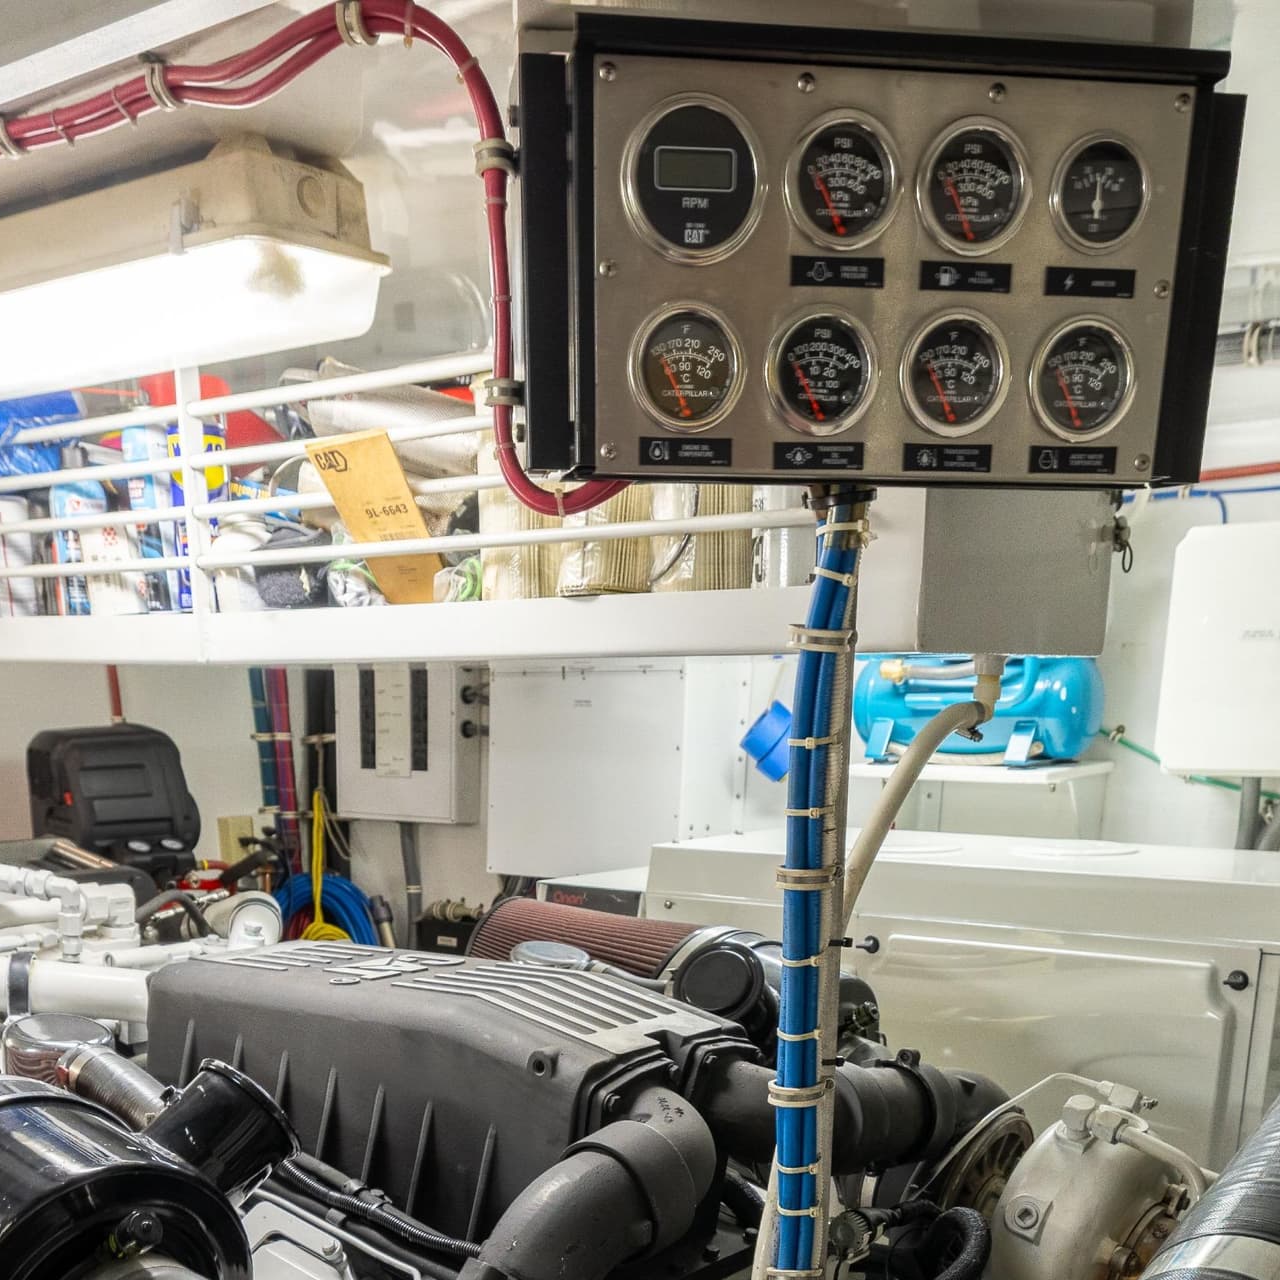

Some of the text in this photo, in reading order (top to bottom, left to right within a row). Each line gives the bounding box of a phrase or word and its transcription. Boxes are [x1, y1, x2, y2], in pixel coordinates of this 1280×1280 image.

[834, 138, 853, 149] PSI
[681, 197, 710, 208] RPM
[684, 229, 705, 243] CAT
[814, 328, 832, 339] PSI
[684, 338, 701, 349] 210
[707, 345, 725, 362] 250
[678, 362, 691, 371] 90
[696, 365, 711, 380] 120
[365, 503, 409, 519] 9L-6643
[553, 890, 584, 905] Onan
